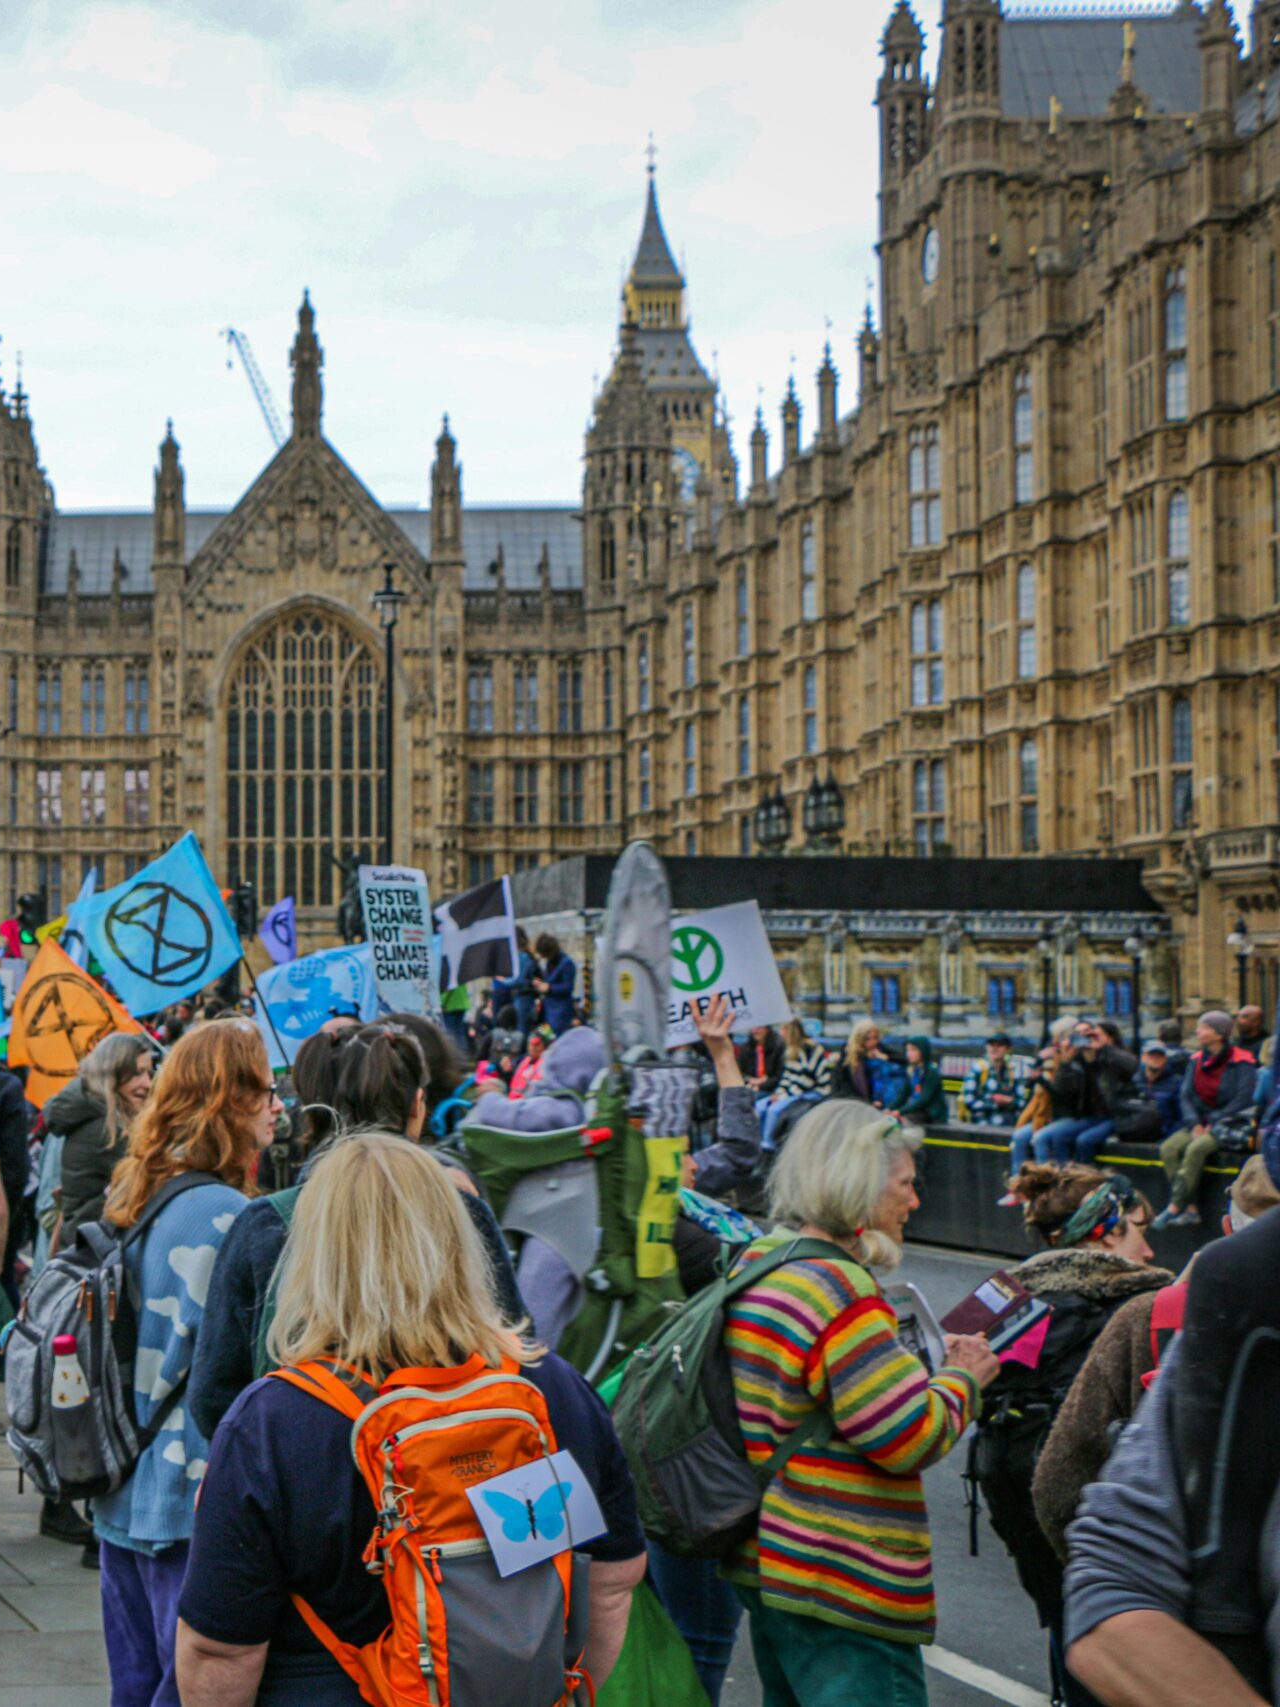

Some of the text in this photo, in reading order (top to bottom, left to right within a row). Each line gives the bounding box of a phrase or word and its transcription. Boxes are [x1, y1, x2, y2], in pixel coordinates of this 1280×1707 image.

[366, 888, 419, 906] SYSTEM
[369, 907, 423, 925] CHANGE
[371, 925, 400, 942] NOT
[374, 945, 428, 962] CLIMATE
[376, 963, 429, 981] CHANGE
[449, 1450, 494, 1467] MYSTERY
